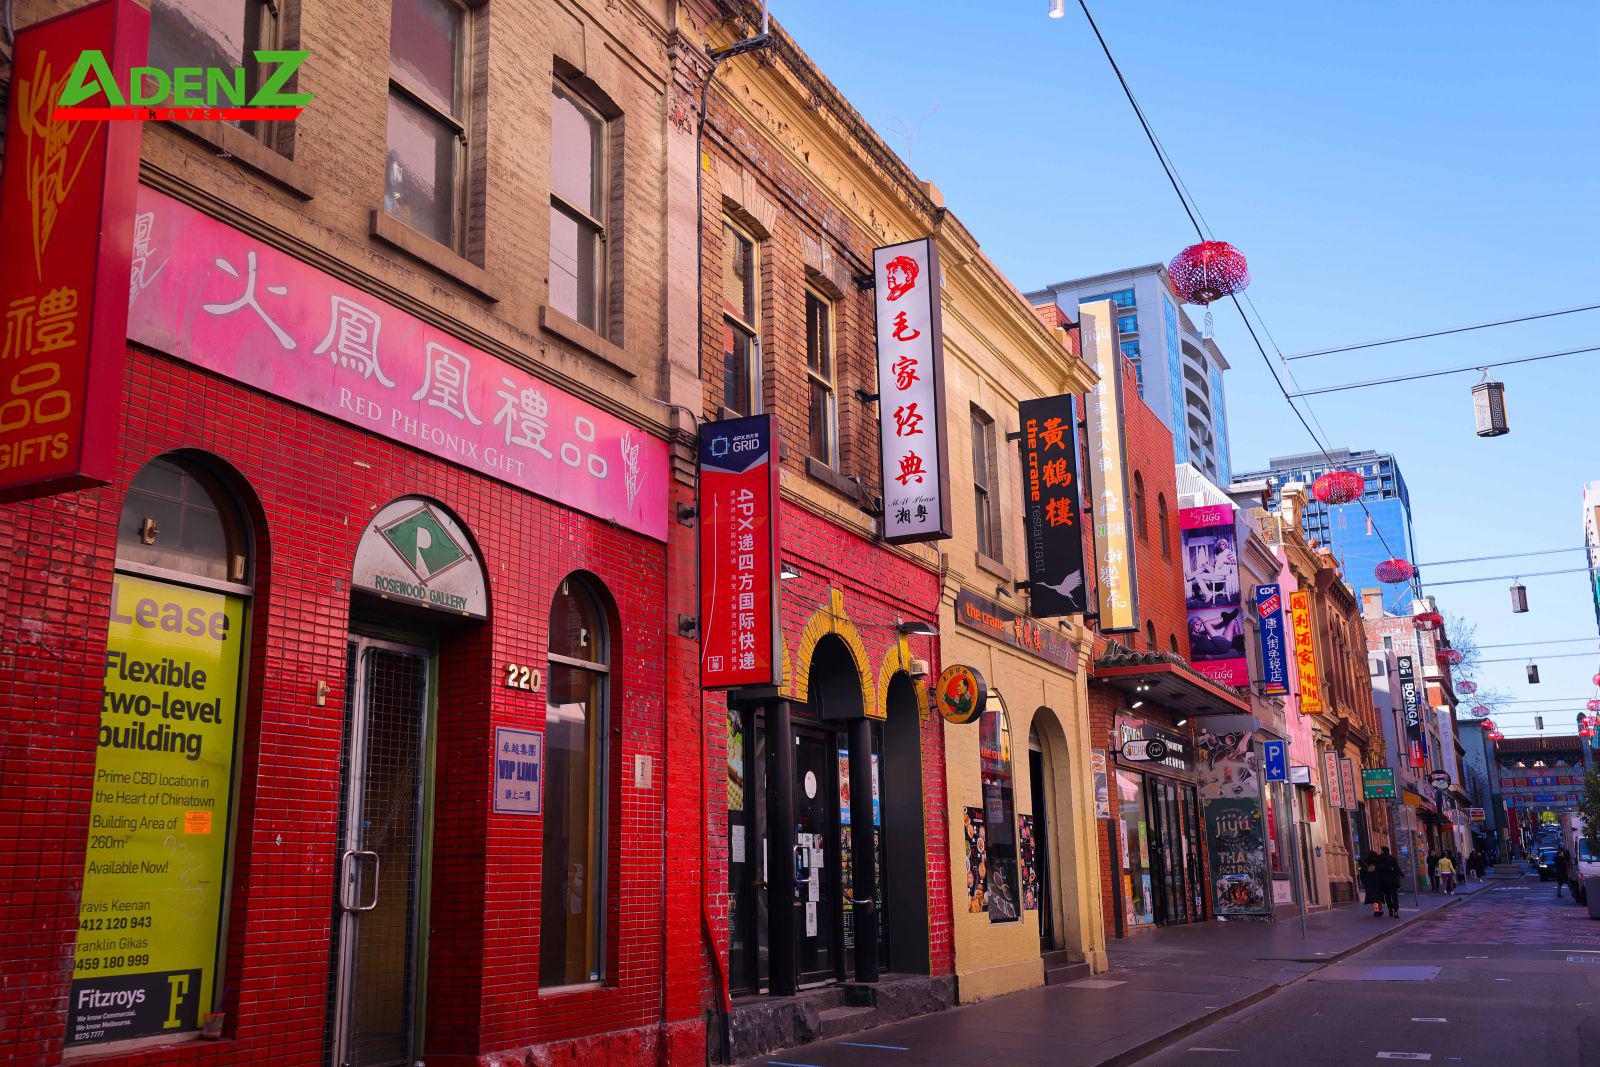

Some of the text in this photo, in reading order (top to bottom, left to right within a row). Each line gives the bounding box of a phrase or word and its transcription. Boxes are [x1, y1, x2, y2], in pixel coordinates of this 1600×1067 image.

[891, 310, 928, 487] 毛家经典
[339, 387, 526, 477] RED PHEONIX GIFT
[1026, 419, 1038, 450] the
[732, 438, 760, 453] GRID
[1028, 451, 1041, 502] crane
[1202, 512, 1220, 523] UGG
[737, 488, 755, 671] 4PX递四方国际快递
[375, 575, 467, 610] ROSEWOOD GALLERY
[111, 582, 230, 641] Lease
[1261, 596, 1277, 610] DUTY
[1263, 603, 1279, 616] FREE
[966, 601, 1005, 632] the crane
[104, 650, 207, 691] Flexible
[508, 664, 541, 693] 220
[1214, 670, 1233, 679] UGG
[1404, 683, 1419, 727] BORNGA
[97, 719, 203, 761] building
[1268, 745, 1280, 762] P
[97, 769, 209, 788] Prime CBD location in
[95, 790, 215, 808] the Heart of Chinatown
[92, 814, 137, 832] Building
[139, 816, 165, 830] Area
[166, 817, 178, 830] of
[1217, 851, 1250, 864] THA
[87, 860, 169, 875] Available Now!
[80, 899, 151, 913] ravis Keenan
[105, 916, 128, 930] 120
[130, 916, 152, 929] 943
[76, 937, 149, 952] ranklin Gikas
[102, 956, 125, 969] 180
[127, 954, 150, 967] 999
[77, 987, 146, 1010] Fitzroys
[76, 1014, 87, 1022] We
[87, 1012, 103, 1022] know
[75, 1023, 86, 1032] We
[86, 1021, 102, 1031] know
